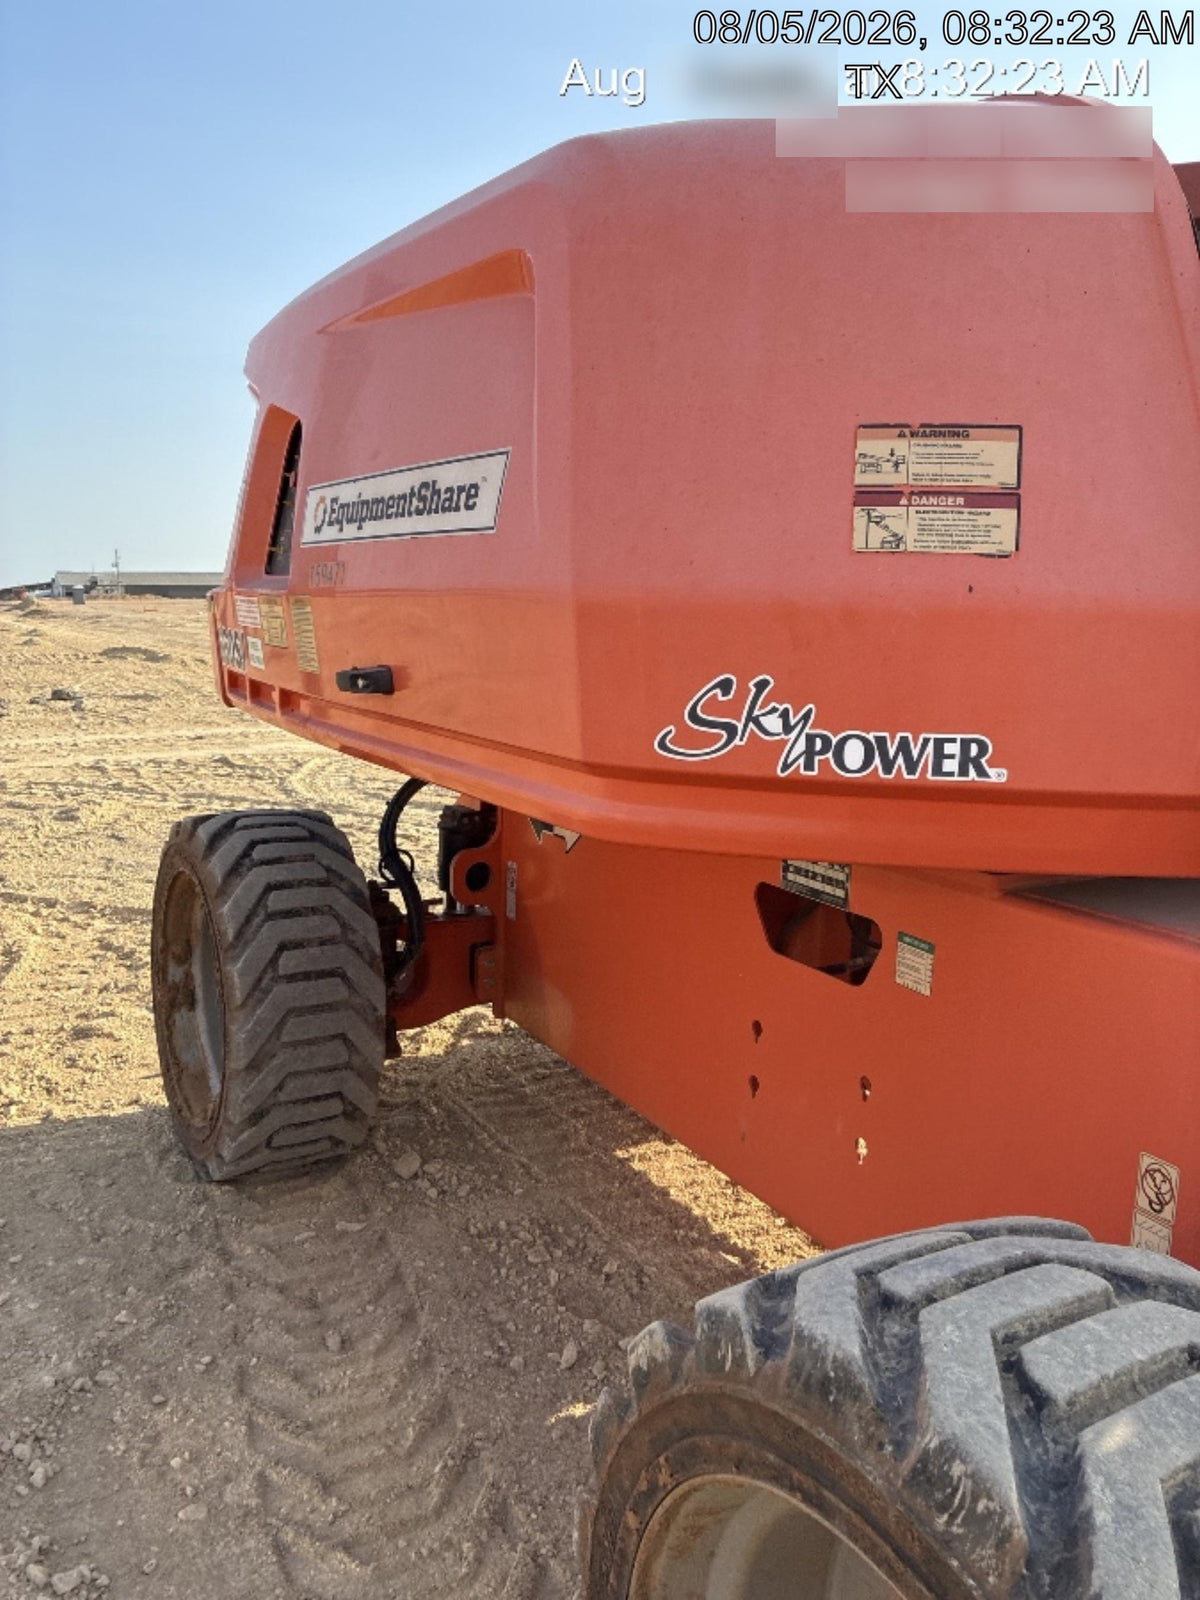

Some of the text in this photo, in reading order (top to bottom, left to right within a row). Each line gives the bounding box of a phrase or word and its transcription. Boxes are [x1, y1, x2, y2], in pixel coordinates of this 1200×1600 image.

[909, 429, 971, 439] WARNING
[327, 478, 480, 534] EquipmentShare
[911, 496, 965, 506] DANGER
